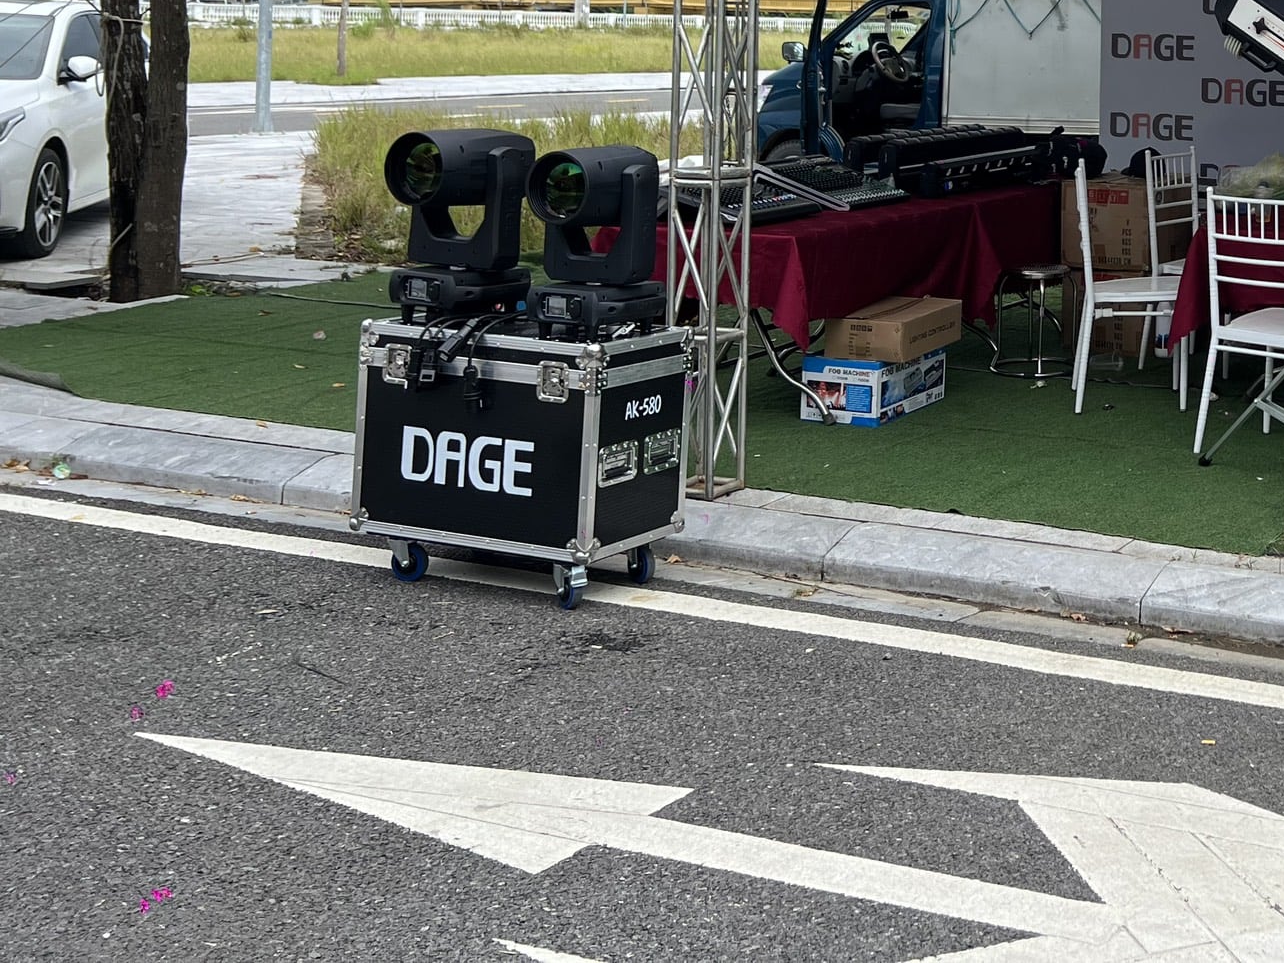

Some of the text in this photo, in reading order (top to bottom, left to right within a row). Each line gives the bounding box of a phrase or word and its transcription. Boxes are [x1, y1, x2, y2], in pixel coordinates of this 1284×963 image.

[1111, 33, 1196, 62] DAGE
[1110, 112, 1194, 141] DAGE
[881, 365, 894, 378] FOG
[625, 394, 662, 421] AK-580
[400, 425, 535, 498] DAGE
